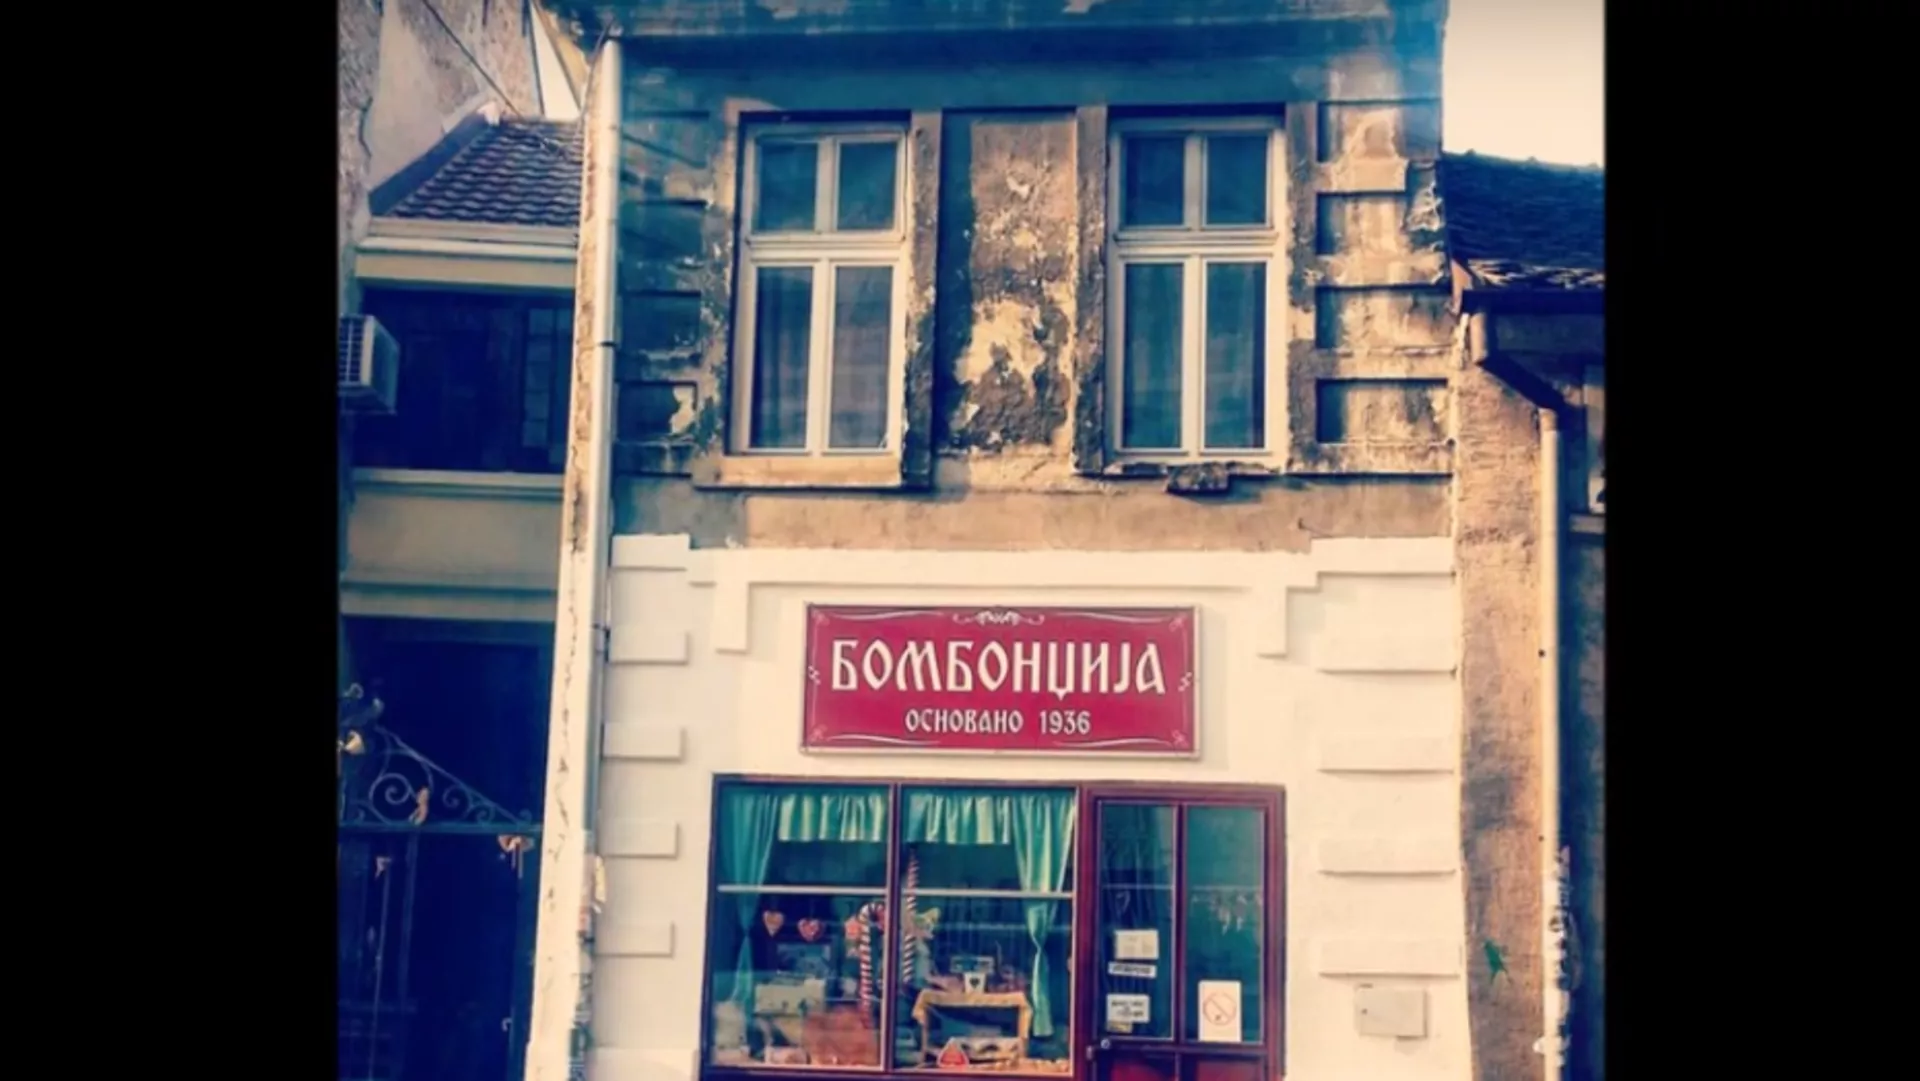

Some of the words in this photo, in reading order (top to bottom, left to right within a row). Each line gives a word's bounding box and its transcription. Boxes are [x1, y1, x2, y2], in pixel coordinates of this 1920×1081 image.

[831, 639, 1165, 701] БОМБОНЏИЈА
[905, 709, 1023, 733] ОСНОВАНО
[1039, 711, 1091, 735] 1936
